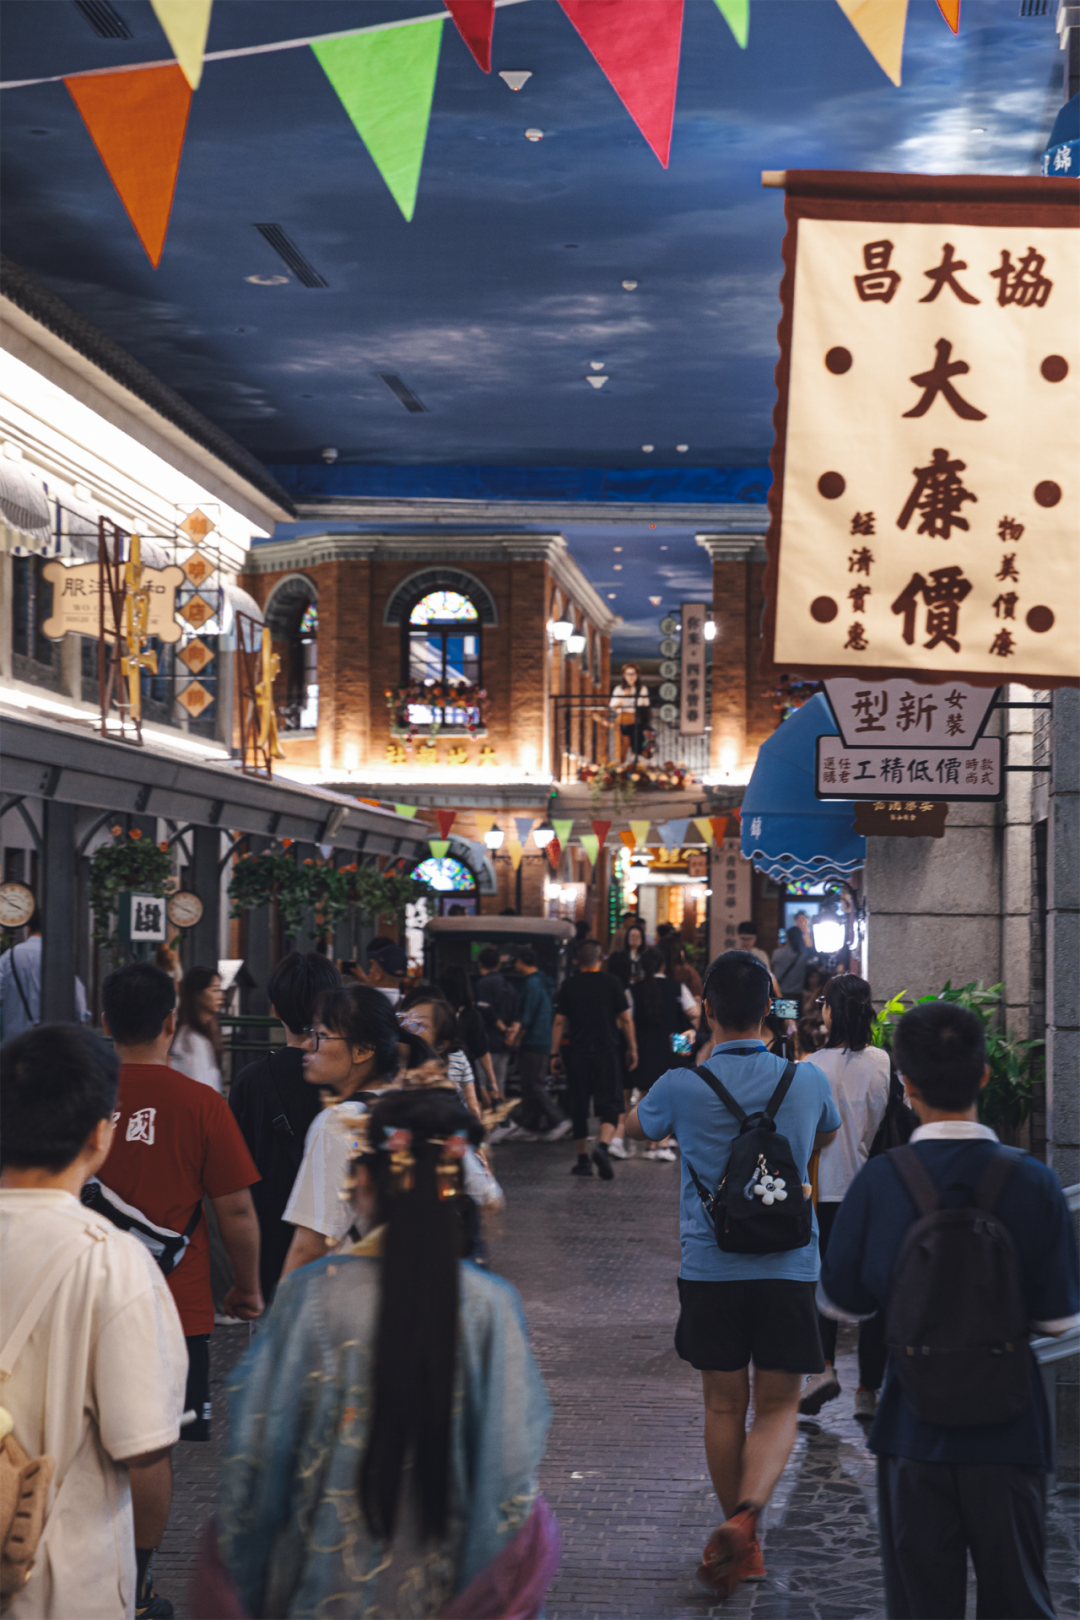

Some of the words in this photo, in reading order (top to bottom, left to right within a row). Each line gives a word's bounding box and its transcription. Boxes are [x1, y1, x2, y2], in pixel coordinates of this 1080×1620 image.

[890, 337, 989, 655] 大廉價
[988, 515, 1026, 658] 物美價廉
[943, 688, 969, 737] 女裝
